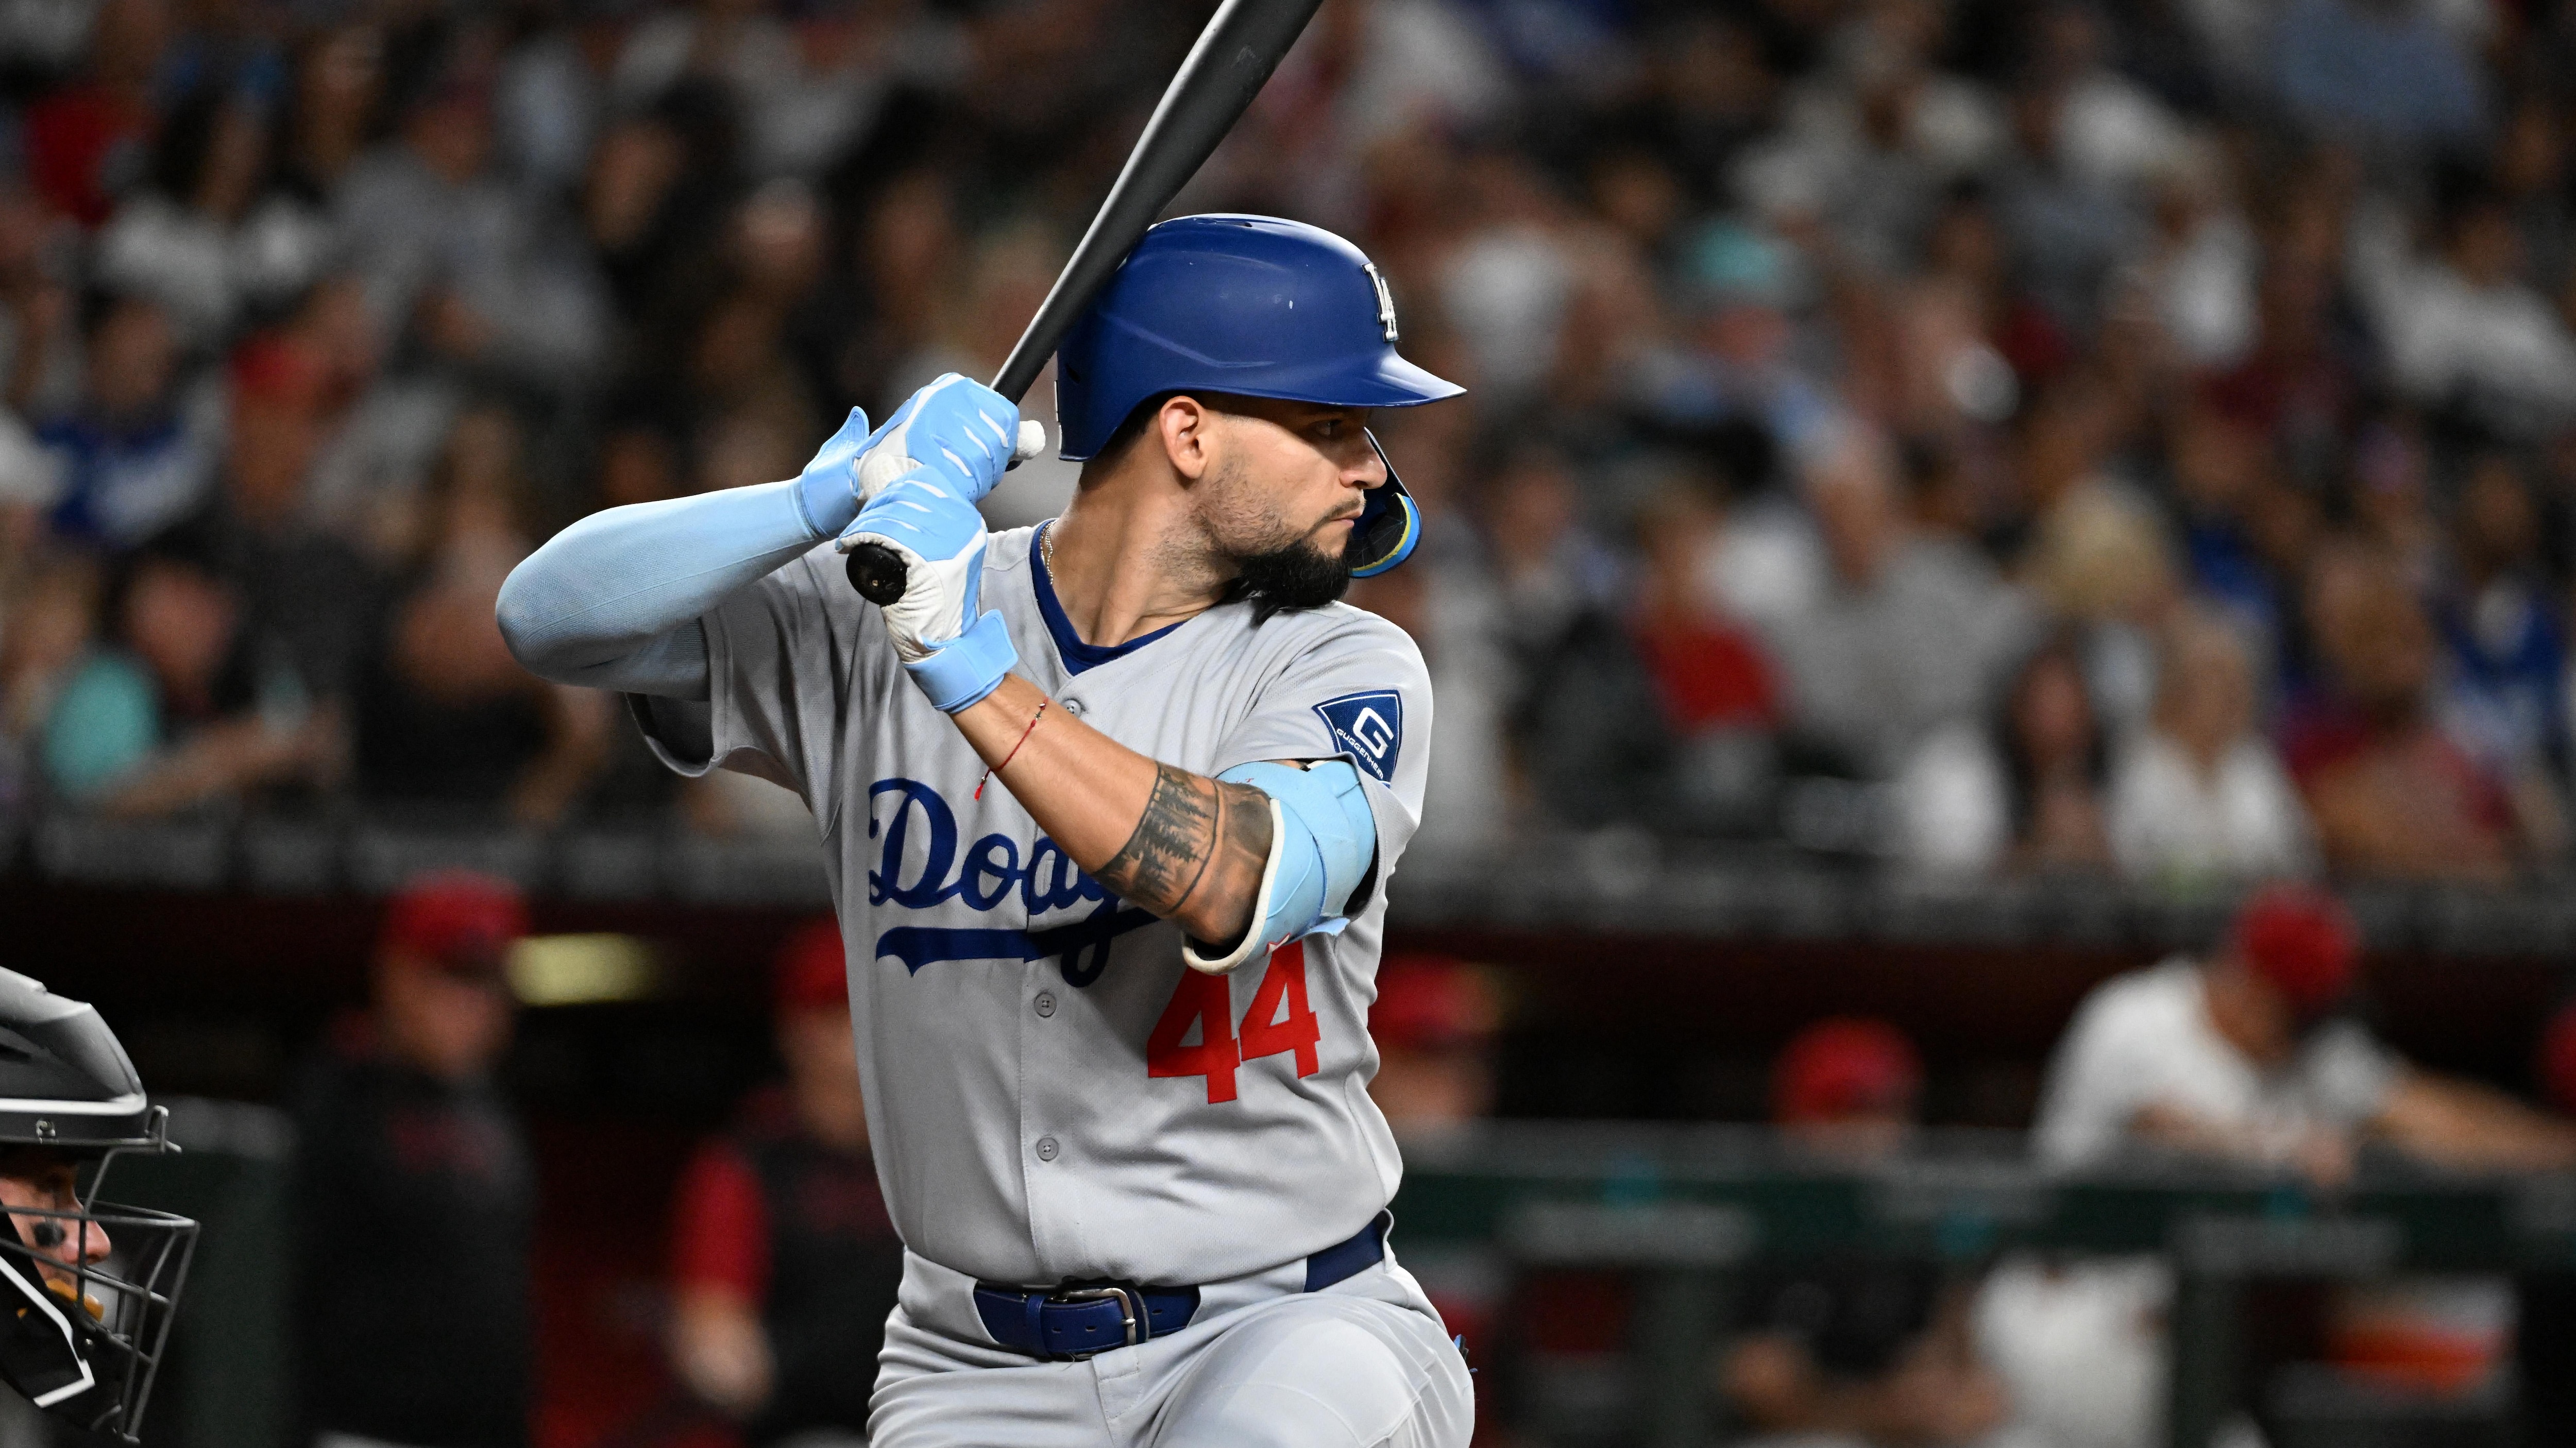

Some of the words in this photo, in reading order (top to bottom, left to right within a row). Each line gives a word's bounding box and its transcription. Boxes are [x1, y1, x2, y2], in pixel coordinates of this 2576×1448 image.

[1336, 728, 1384, 779] GUGGENHEIM
[1352, 707, 1394, 759] G
[869, 778, 1122, 988] Dodg
[1147, 940, 1321, 1104] 44
